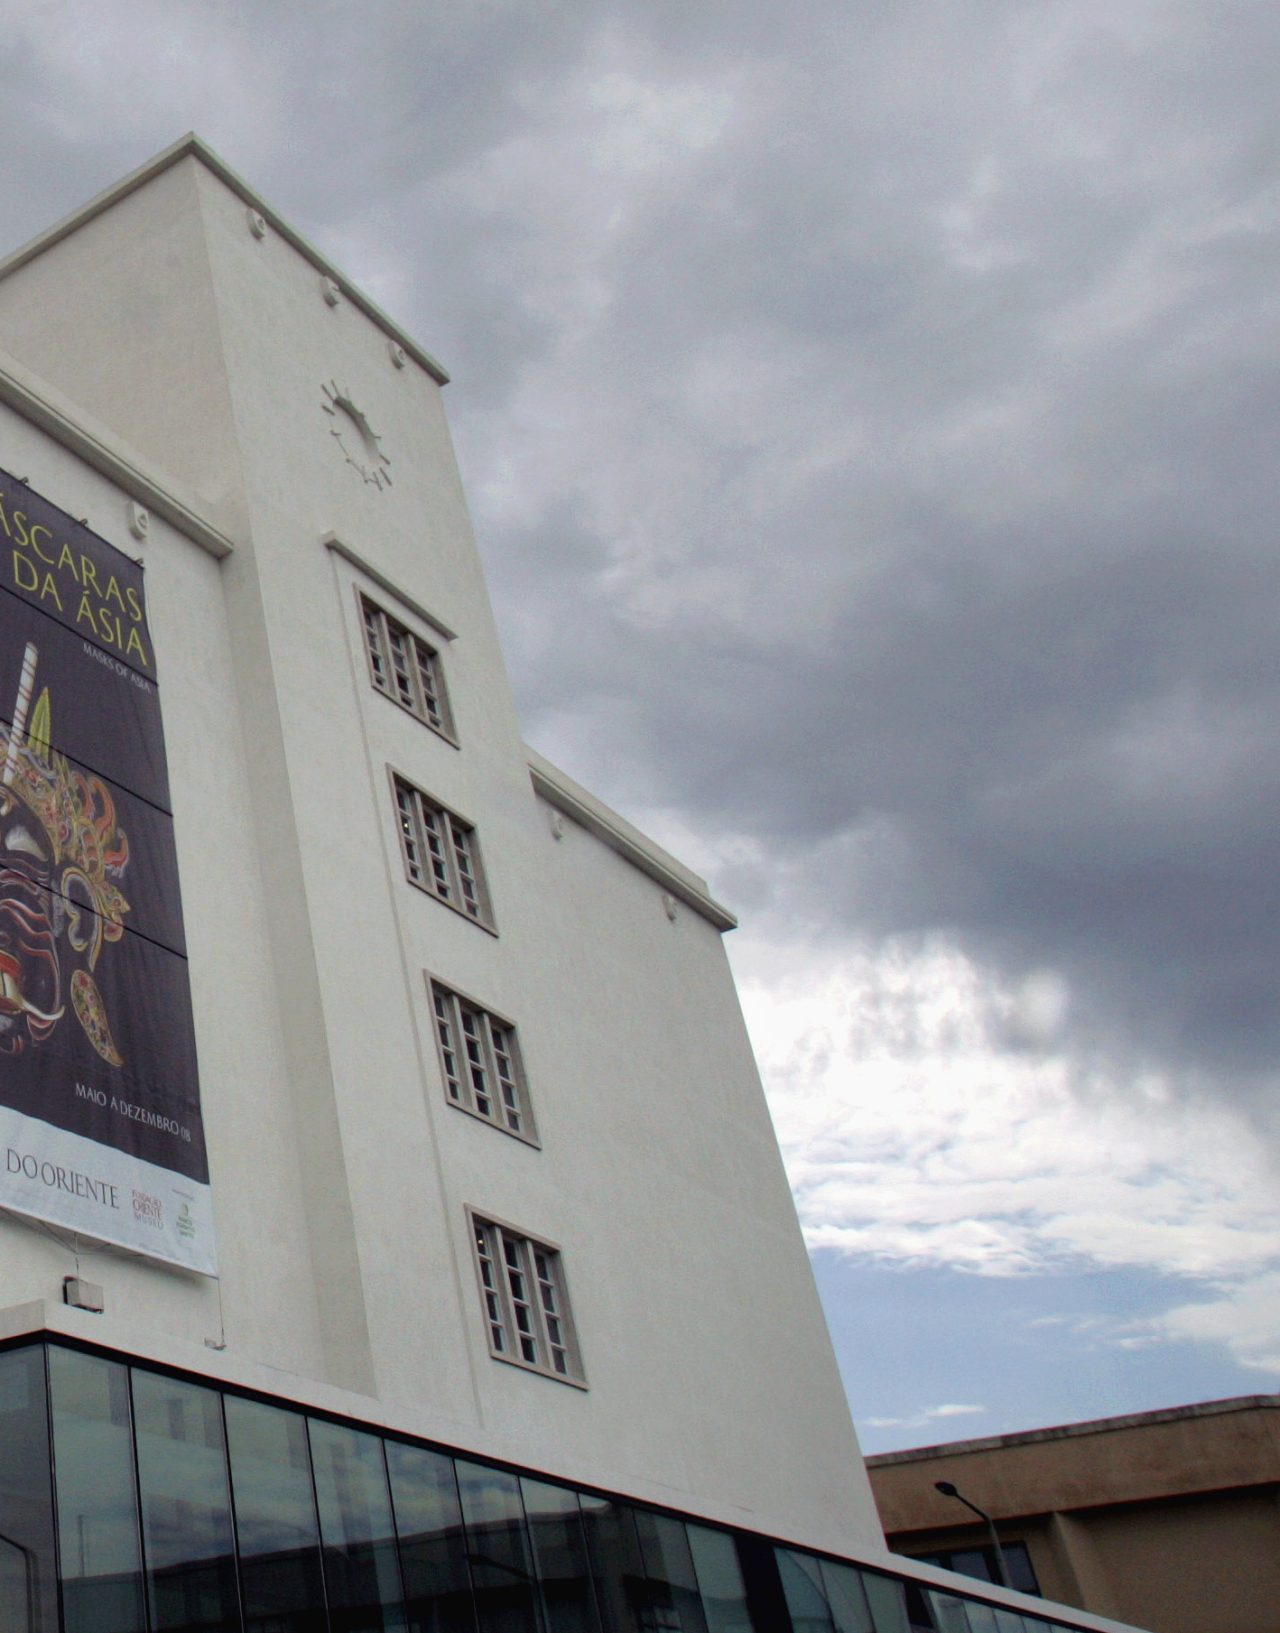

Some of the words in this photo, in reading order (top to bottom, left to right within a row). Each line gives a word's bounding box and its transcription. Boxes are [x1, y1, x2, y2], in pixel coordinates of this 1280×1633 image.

[12, 549, 63, 611] DA
[76, 591, 147, 666] ÁSIA
[83, 642, 114, 670] MASKS
[115, 663, 128, 678] OF
[130, 673, 152, 696] ASIA
[75, 1082, 107, 1107] MAIO
[110, 1096, 119, 1111] A
[120, 1101, 179, 1136] DEZEMBRO
[6, 1148, 38, 1179] DO
[41, 1162, 120, 1210] ORIENTE
